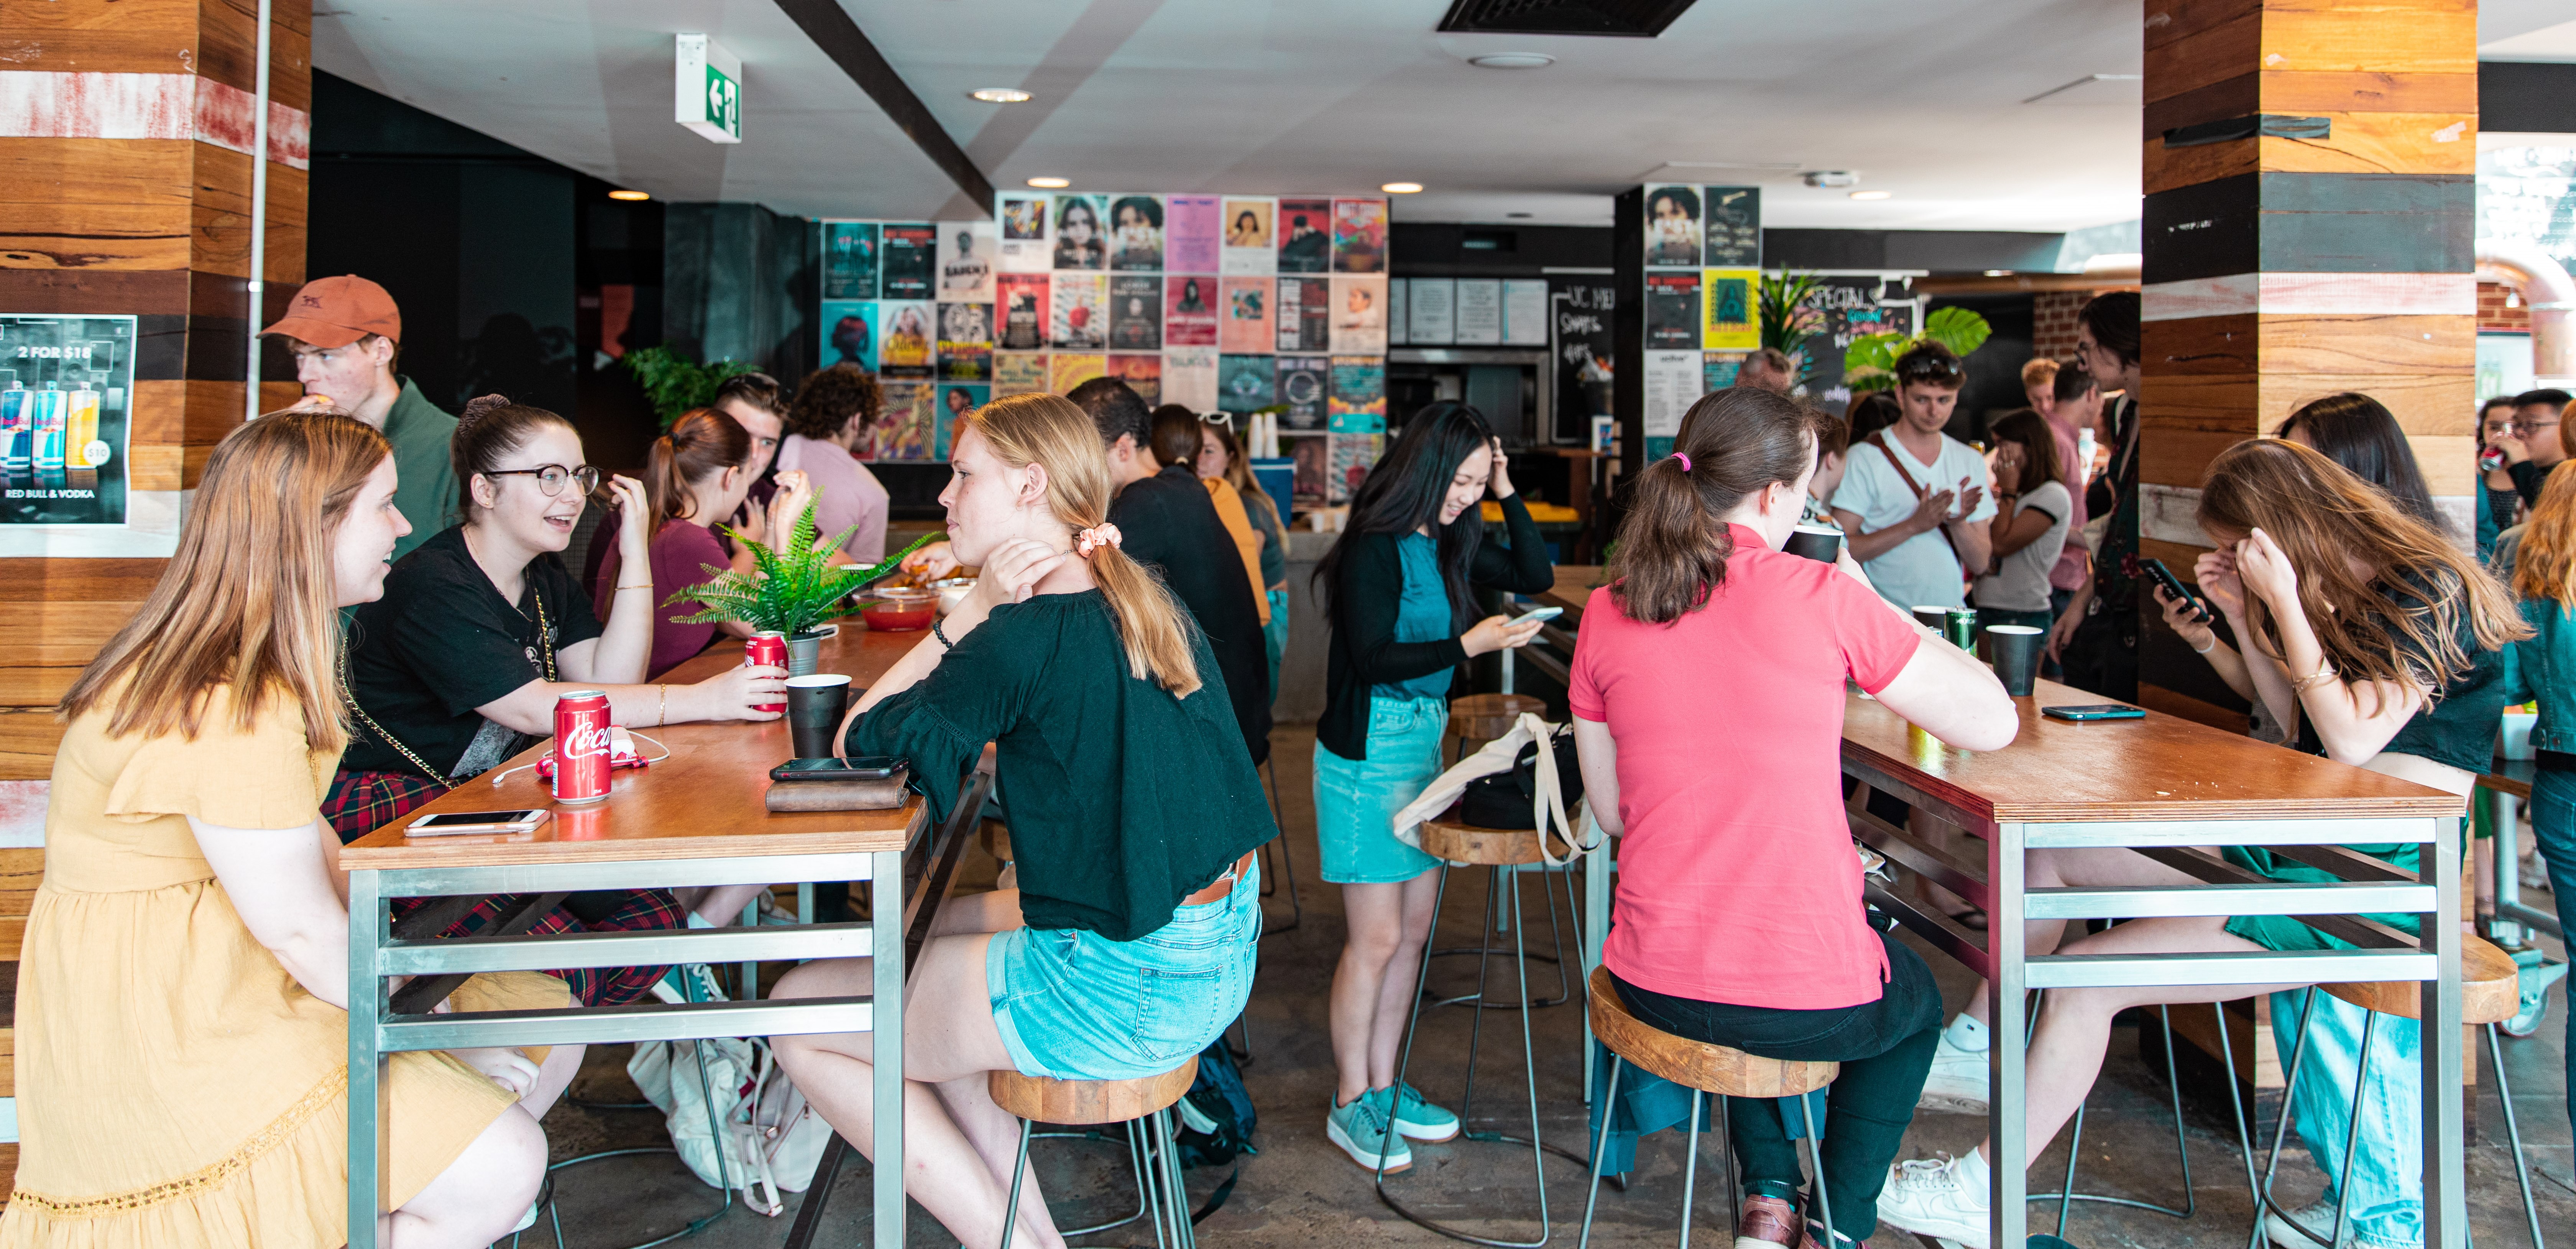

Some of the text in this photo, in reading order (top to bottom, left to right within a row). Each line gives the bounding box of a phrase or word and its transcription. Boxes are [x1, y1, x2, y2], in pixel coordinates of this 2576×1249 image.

[18, 346, 92, 360] 2 FOR $18
[88, 449, 107, 457] $10
[5, 489, 95, 498] RED BULL & VODKA
[564, 721, 611, 759] Coca
